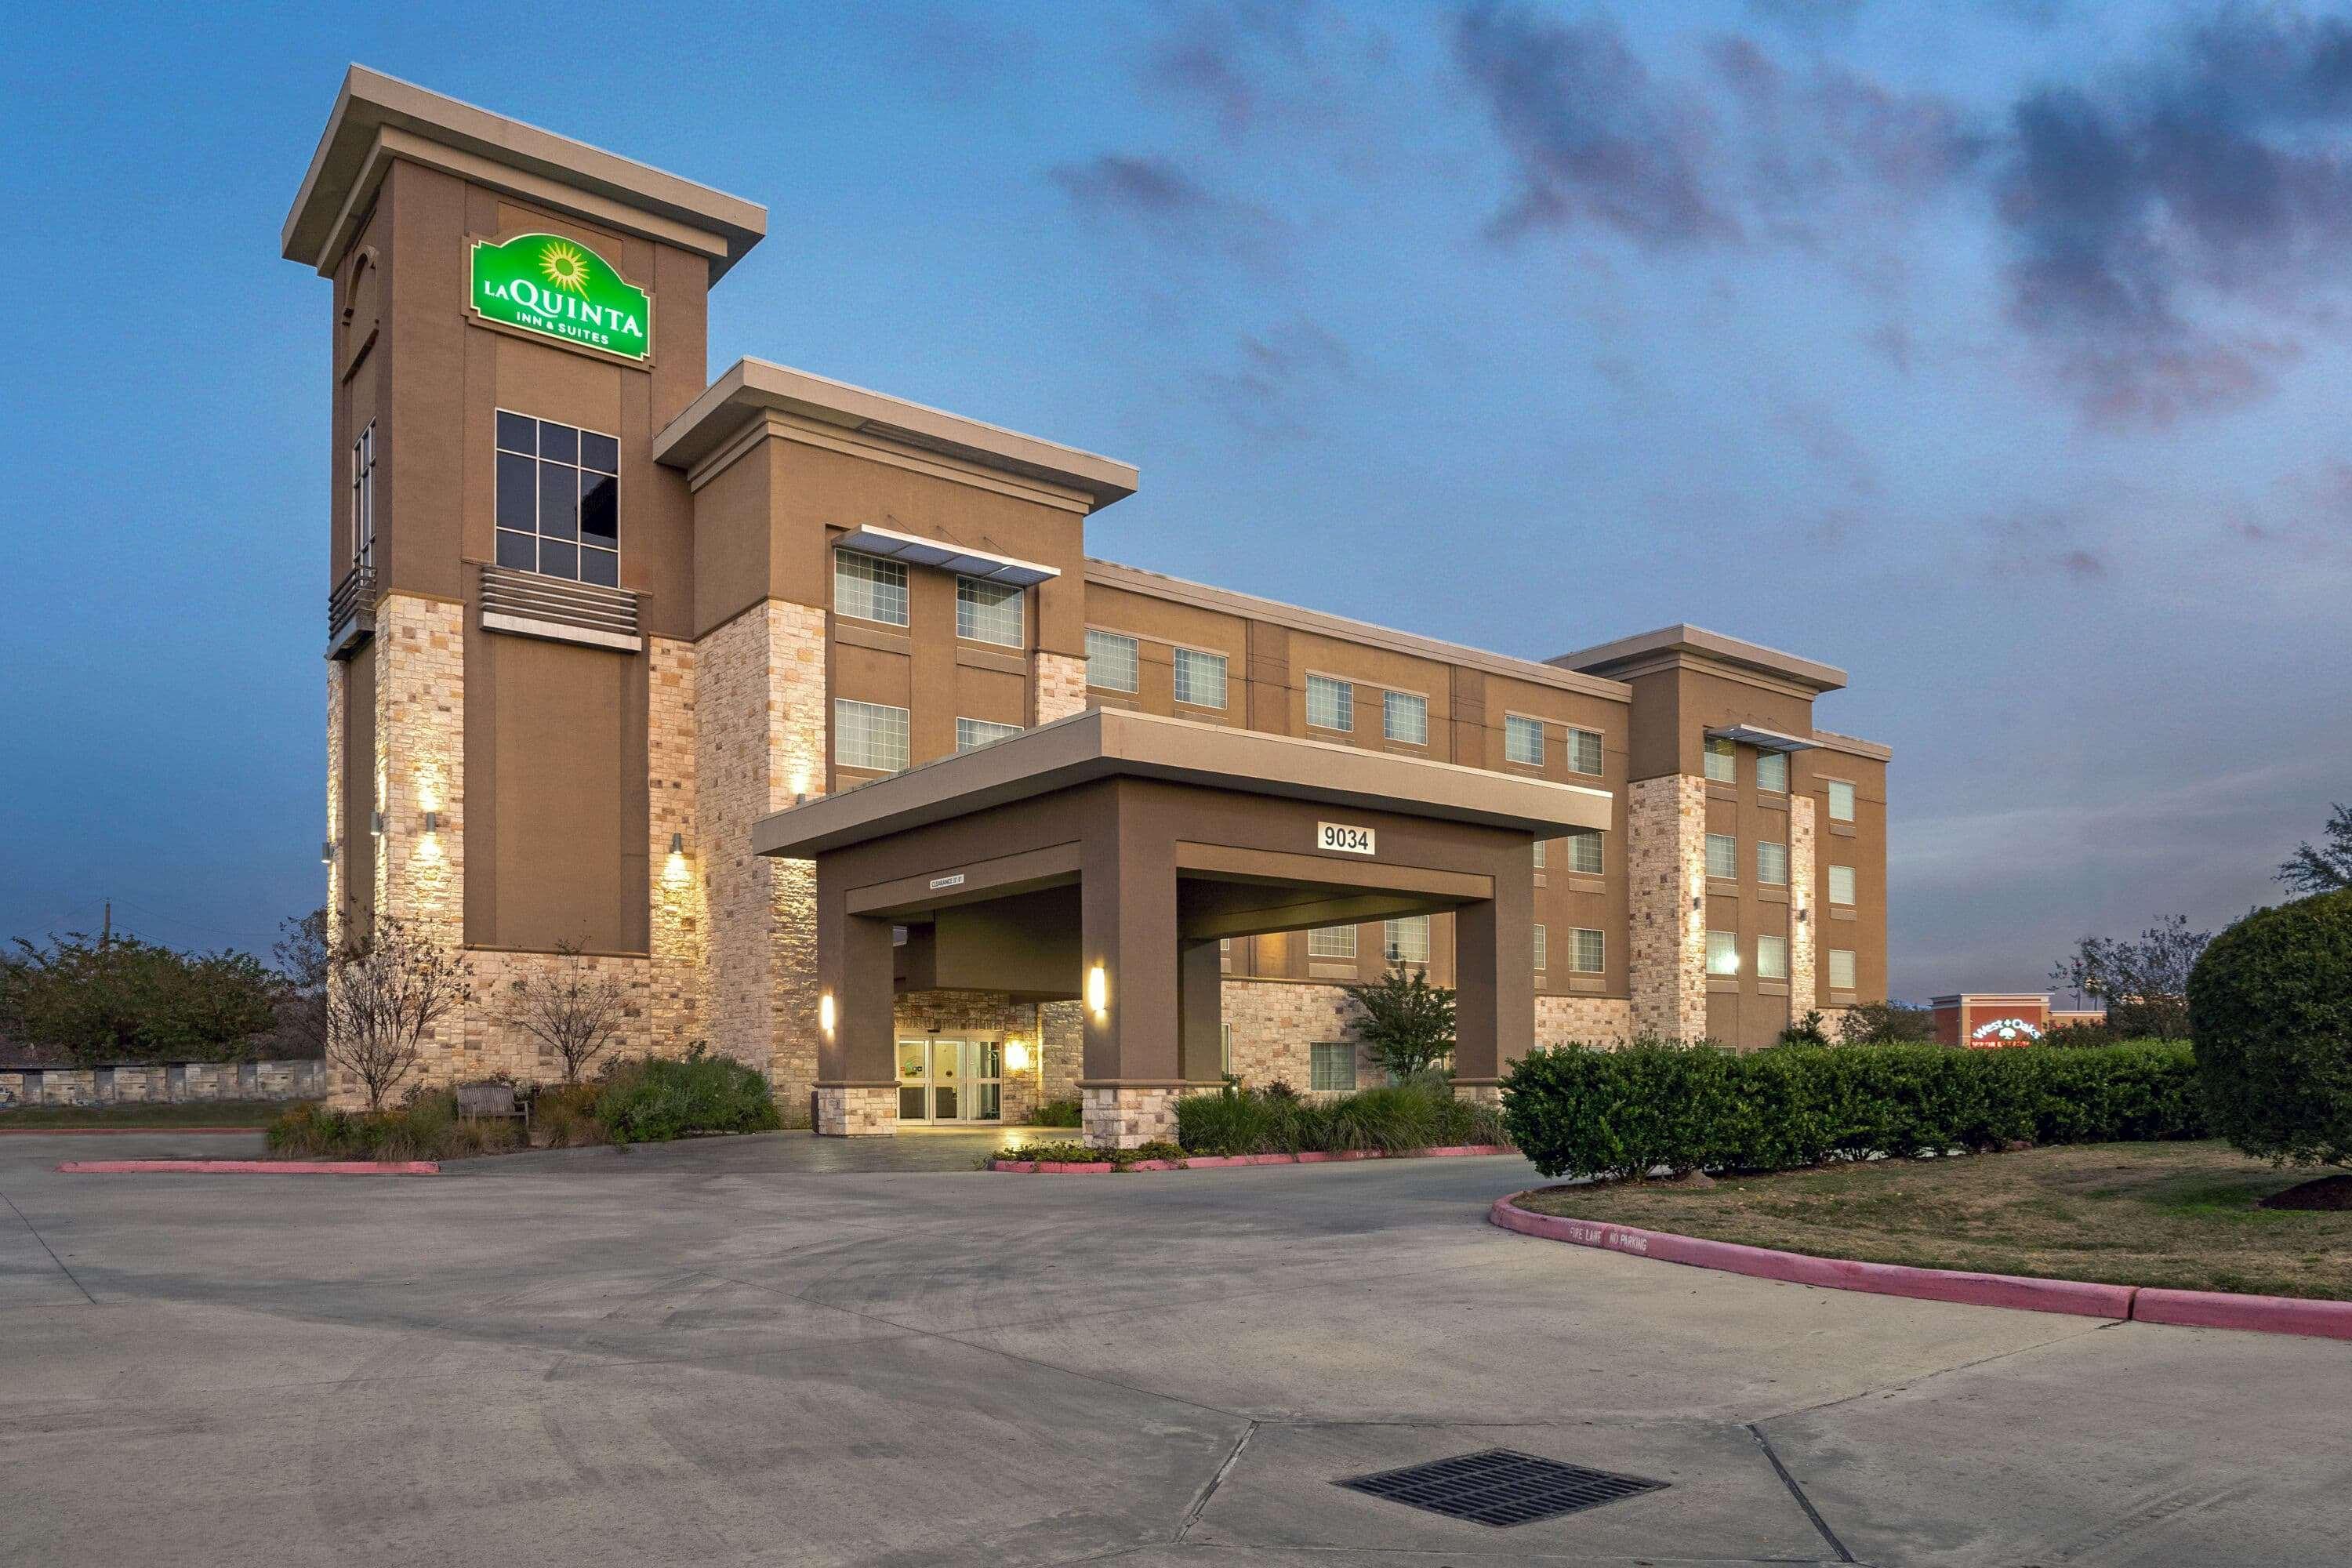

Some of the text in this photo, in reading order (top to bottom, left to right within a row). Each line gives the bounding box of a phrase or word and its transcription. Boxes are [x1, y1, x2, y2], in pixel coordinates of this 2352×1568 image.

[517, 311, 609, 345] INN & SUITES
[1325, 826, 1368, 851] 9034
[1610, 1232, 1619, 1244] NO
[1621, 1234, 1647, 1251] PARKING
